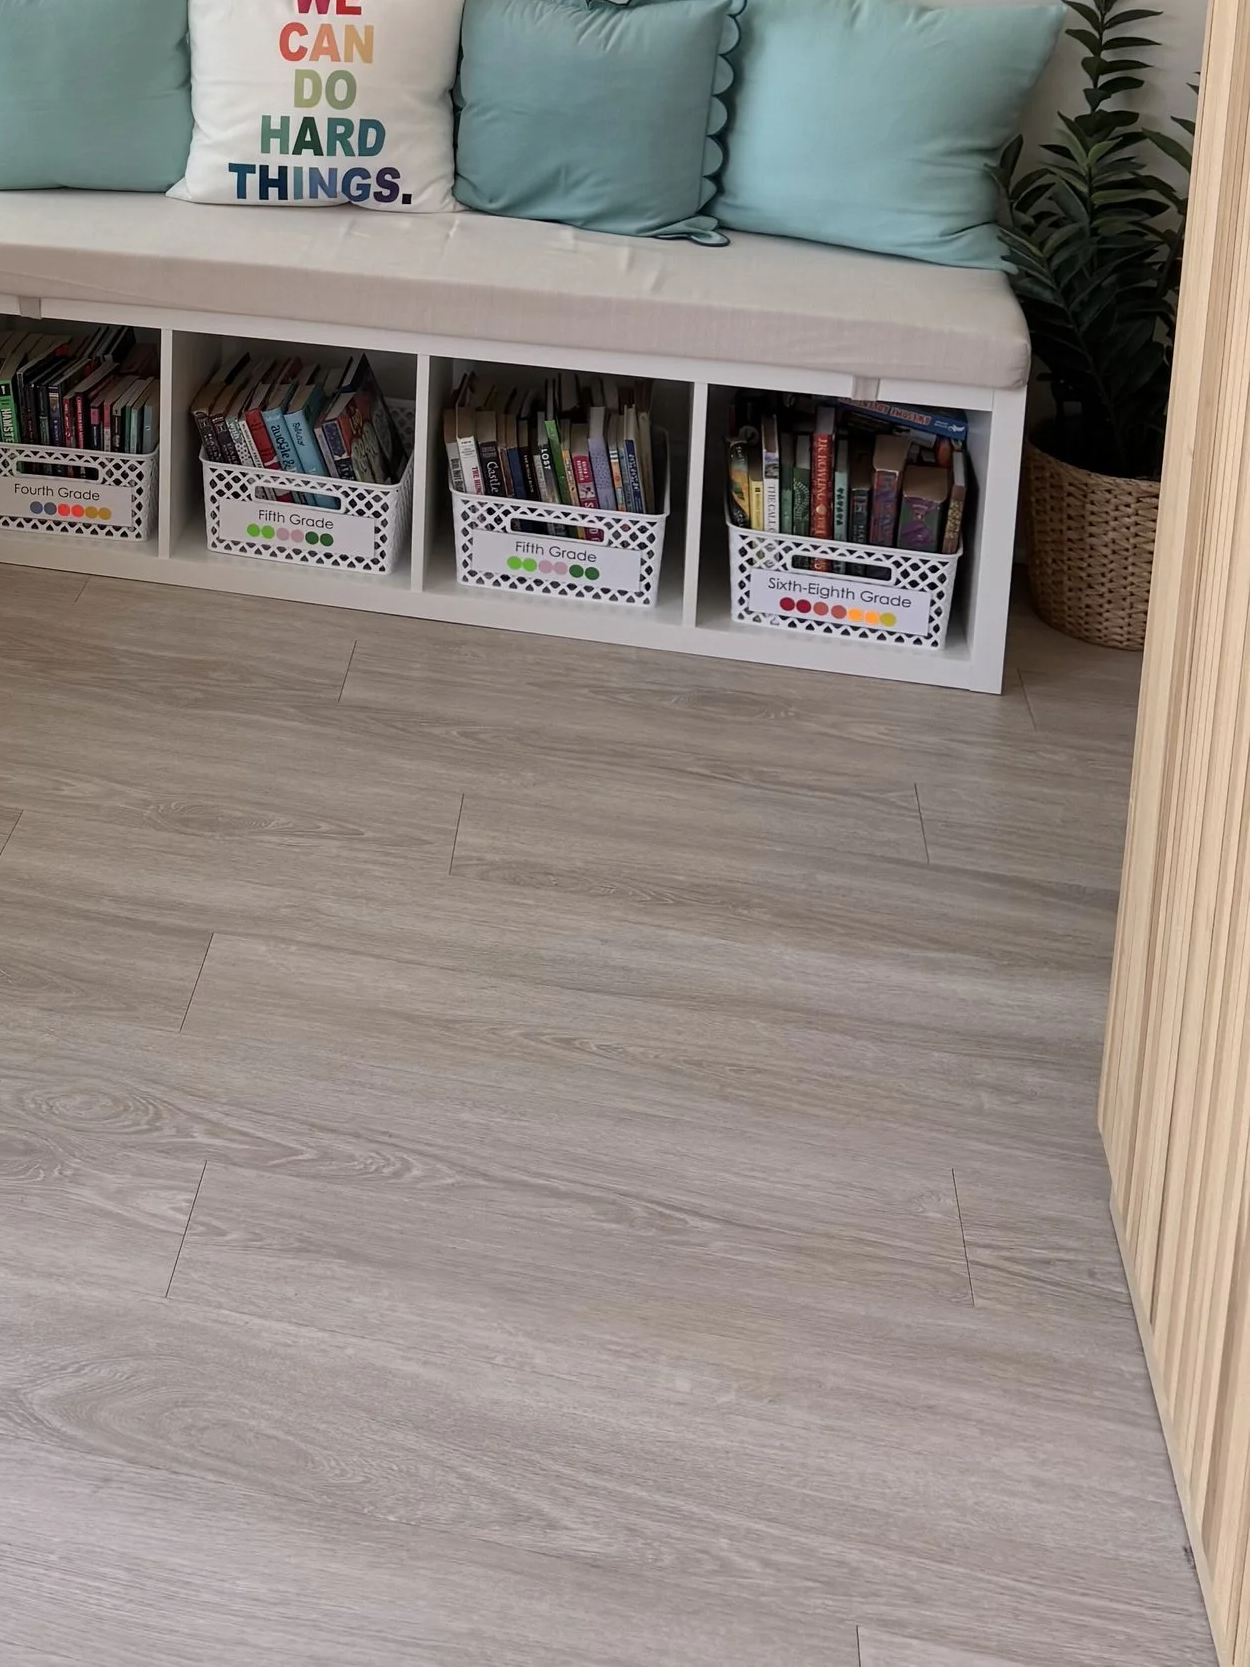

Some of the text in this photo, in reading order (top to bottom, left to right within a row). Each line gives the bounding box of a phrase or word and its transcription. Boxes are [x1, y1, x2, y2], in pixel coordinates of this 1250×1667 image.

[279, 22, 374, 64] CAN
[293, 69, 357, 110] DO
[260, 115, 386, 157] HARD
[228, 163, 412, 204] THINGS.
[541, 448, 551, 470] LOST
[14, 483, 100, 501] Fourth Grade
[817, 455, 827, 500] ROWLING
[258, 509, 334, 530] Fifth Grade
[515, 541, 597, 563] Fifth Grade
[768, 577, 912, 608] Sixth-Eighth Grade
